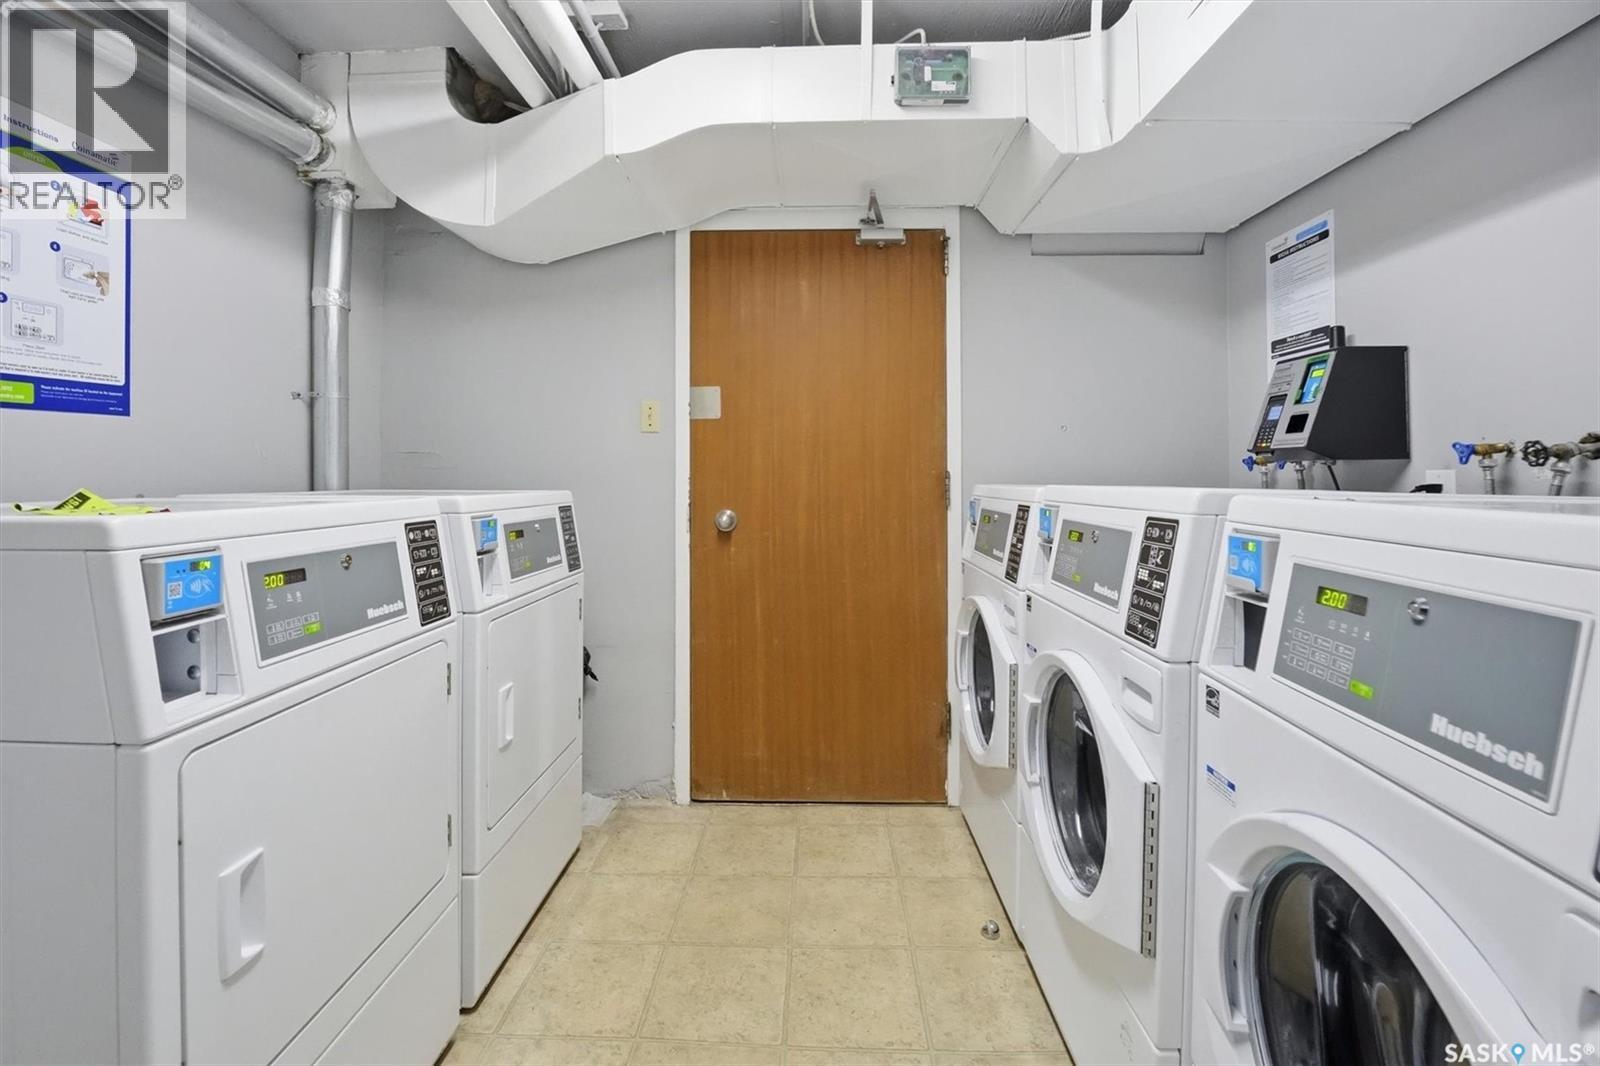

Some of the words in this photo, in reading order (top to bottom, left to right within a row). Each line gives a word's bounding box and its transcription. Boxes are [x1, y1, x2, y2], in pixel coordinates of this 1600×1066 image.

[3, 113, 59, 143] Instructions
[366, 599, 405, 620] Huebsch
[1430, 712, 1545, 781] Huebsch
